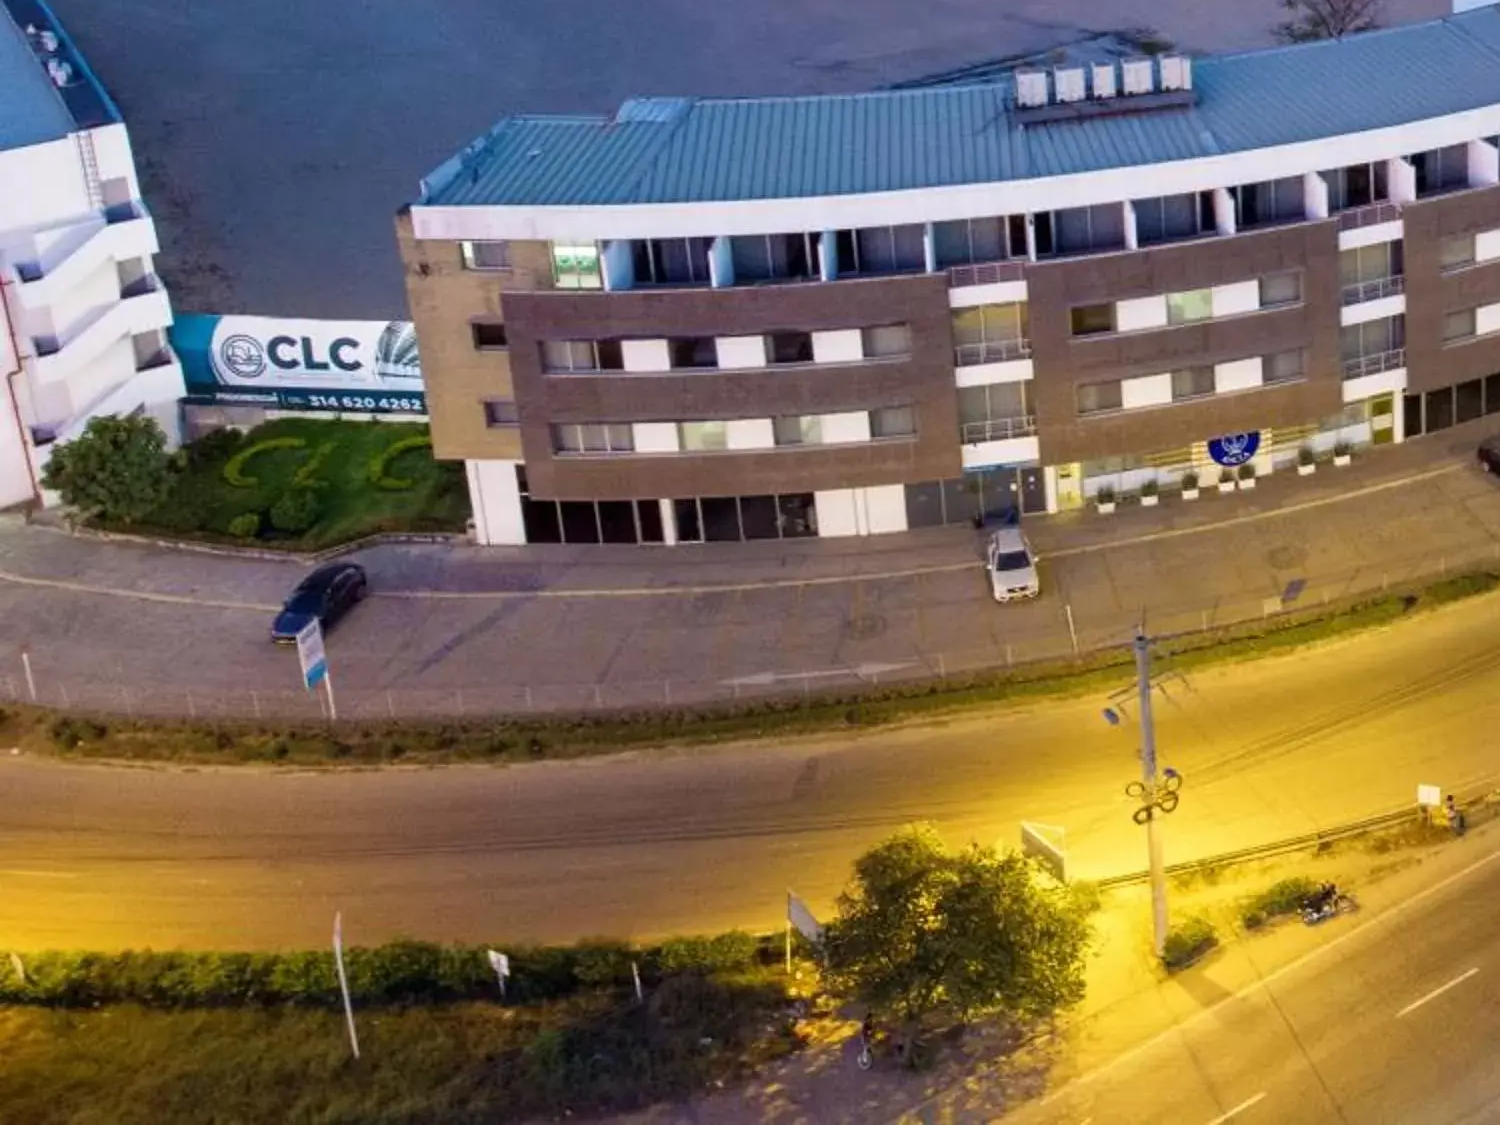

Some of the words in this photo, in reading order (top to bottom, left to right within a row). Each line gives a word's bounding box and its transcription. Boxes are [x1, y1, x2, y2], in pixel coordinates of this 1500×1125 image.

[267, 335, 364, 372] CLC
[308, 395, 339, 408] 314
[378, 397, 423, 411] 4262
